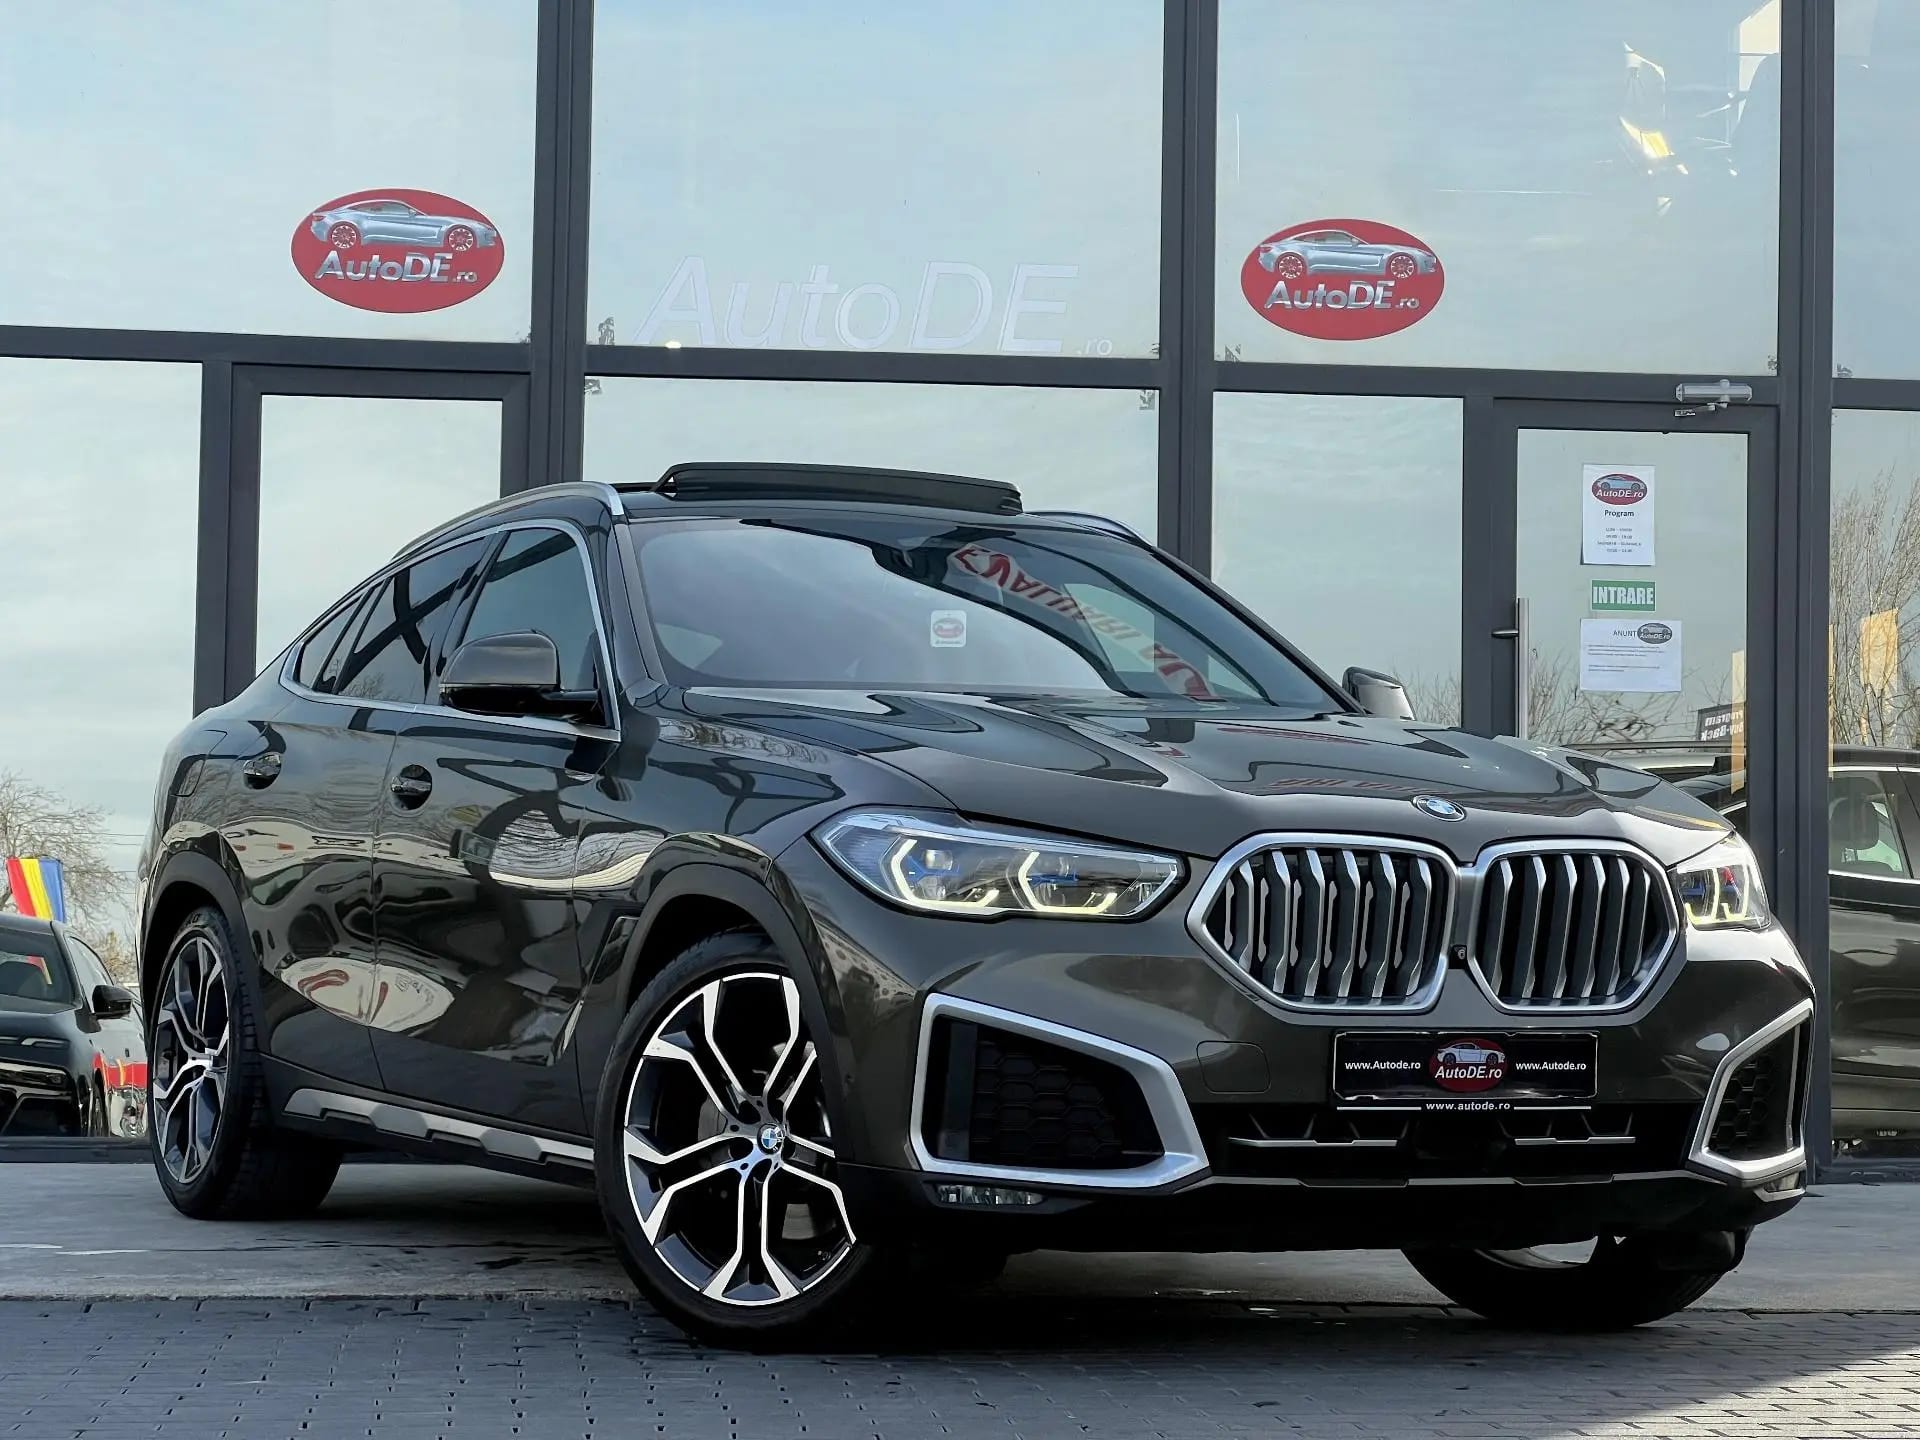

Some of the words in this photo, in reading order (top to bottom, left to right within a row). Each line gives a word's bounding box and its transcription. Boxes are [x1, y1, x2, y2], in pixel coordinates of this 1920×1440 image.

[1595, 489, 1645, 499] AutoDE.ro
[1604, 509, 1635, 518] Program
[1592, 585, 1655, 606] INTRARE
[1345, 1060, 1421, 1070] www.Autode.ro
[1515, 1061, 1587, 1071] www.Autode.ro
[1434, 1066, 1503, 1080] AutoDE.ro
[1426, 1101, 1511, 1111] www.autode.ro
